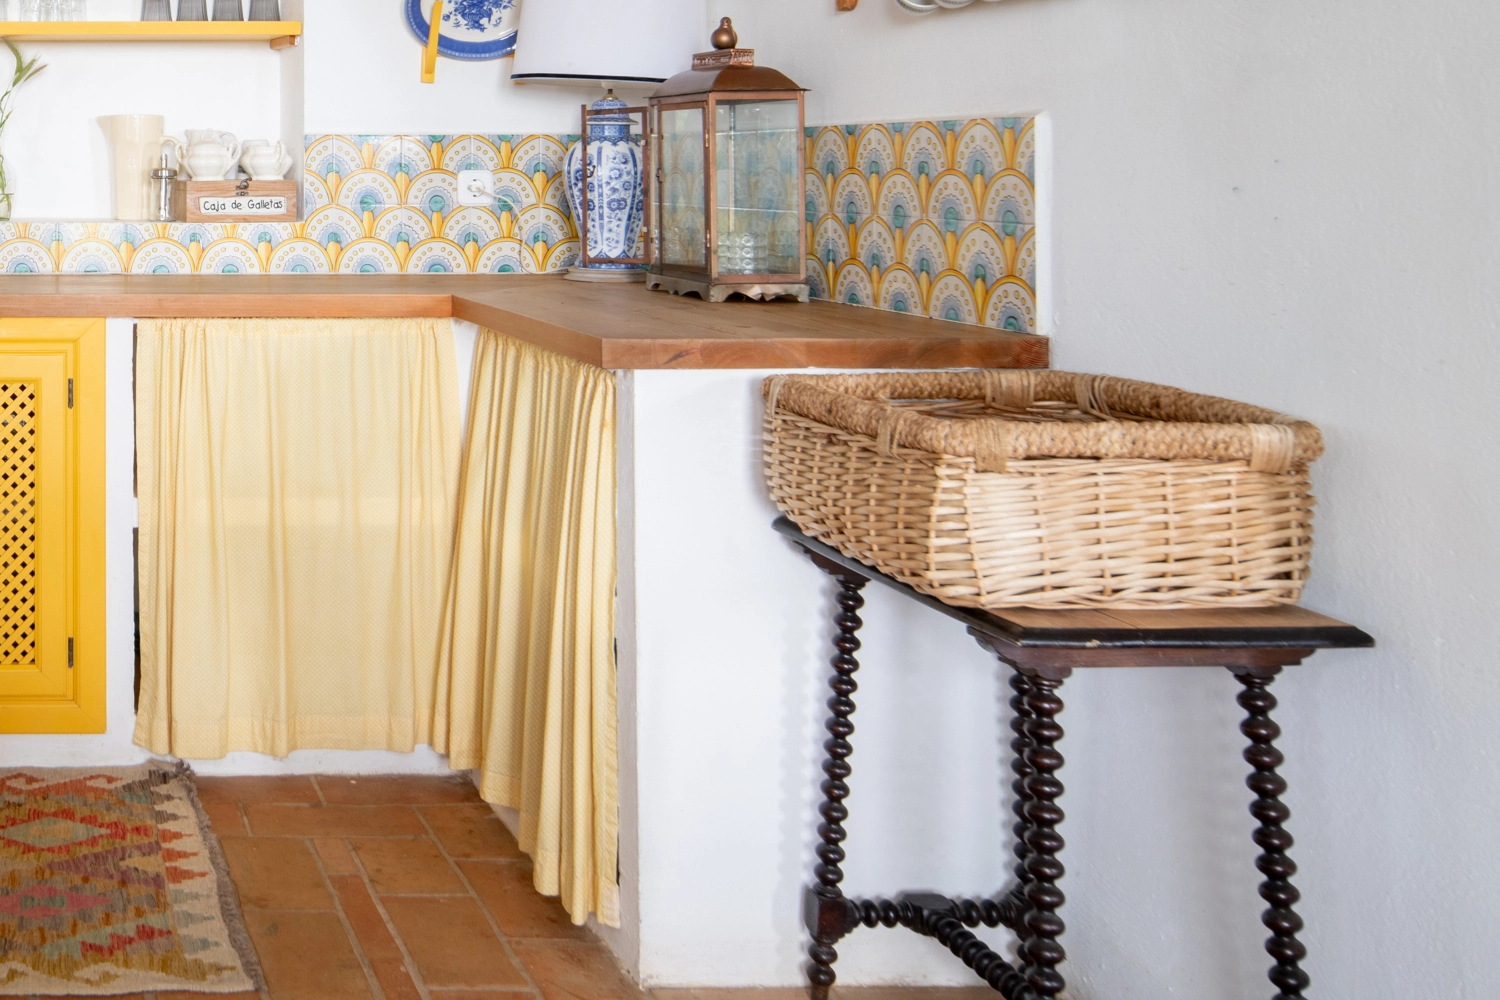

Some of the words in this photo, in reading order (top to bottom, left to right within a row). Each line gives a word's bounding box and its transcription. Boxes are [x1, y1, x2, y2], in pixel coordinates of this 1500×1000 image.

[203, 201, 226, 212] Caja
[231, 200, 242, 210] de
[247, 199, 283, 210] Galletas
